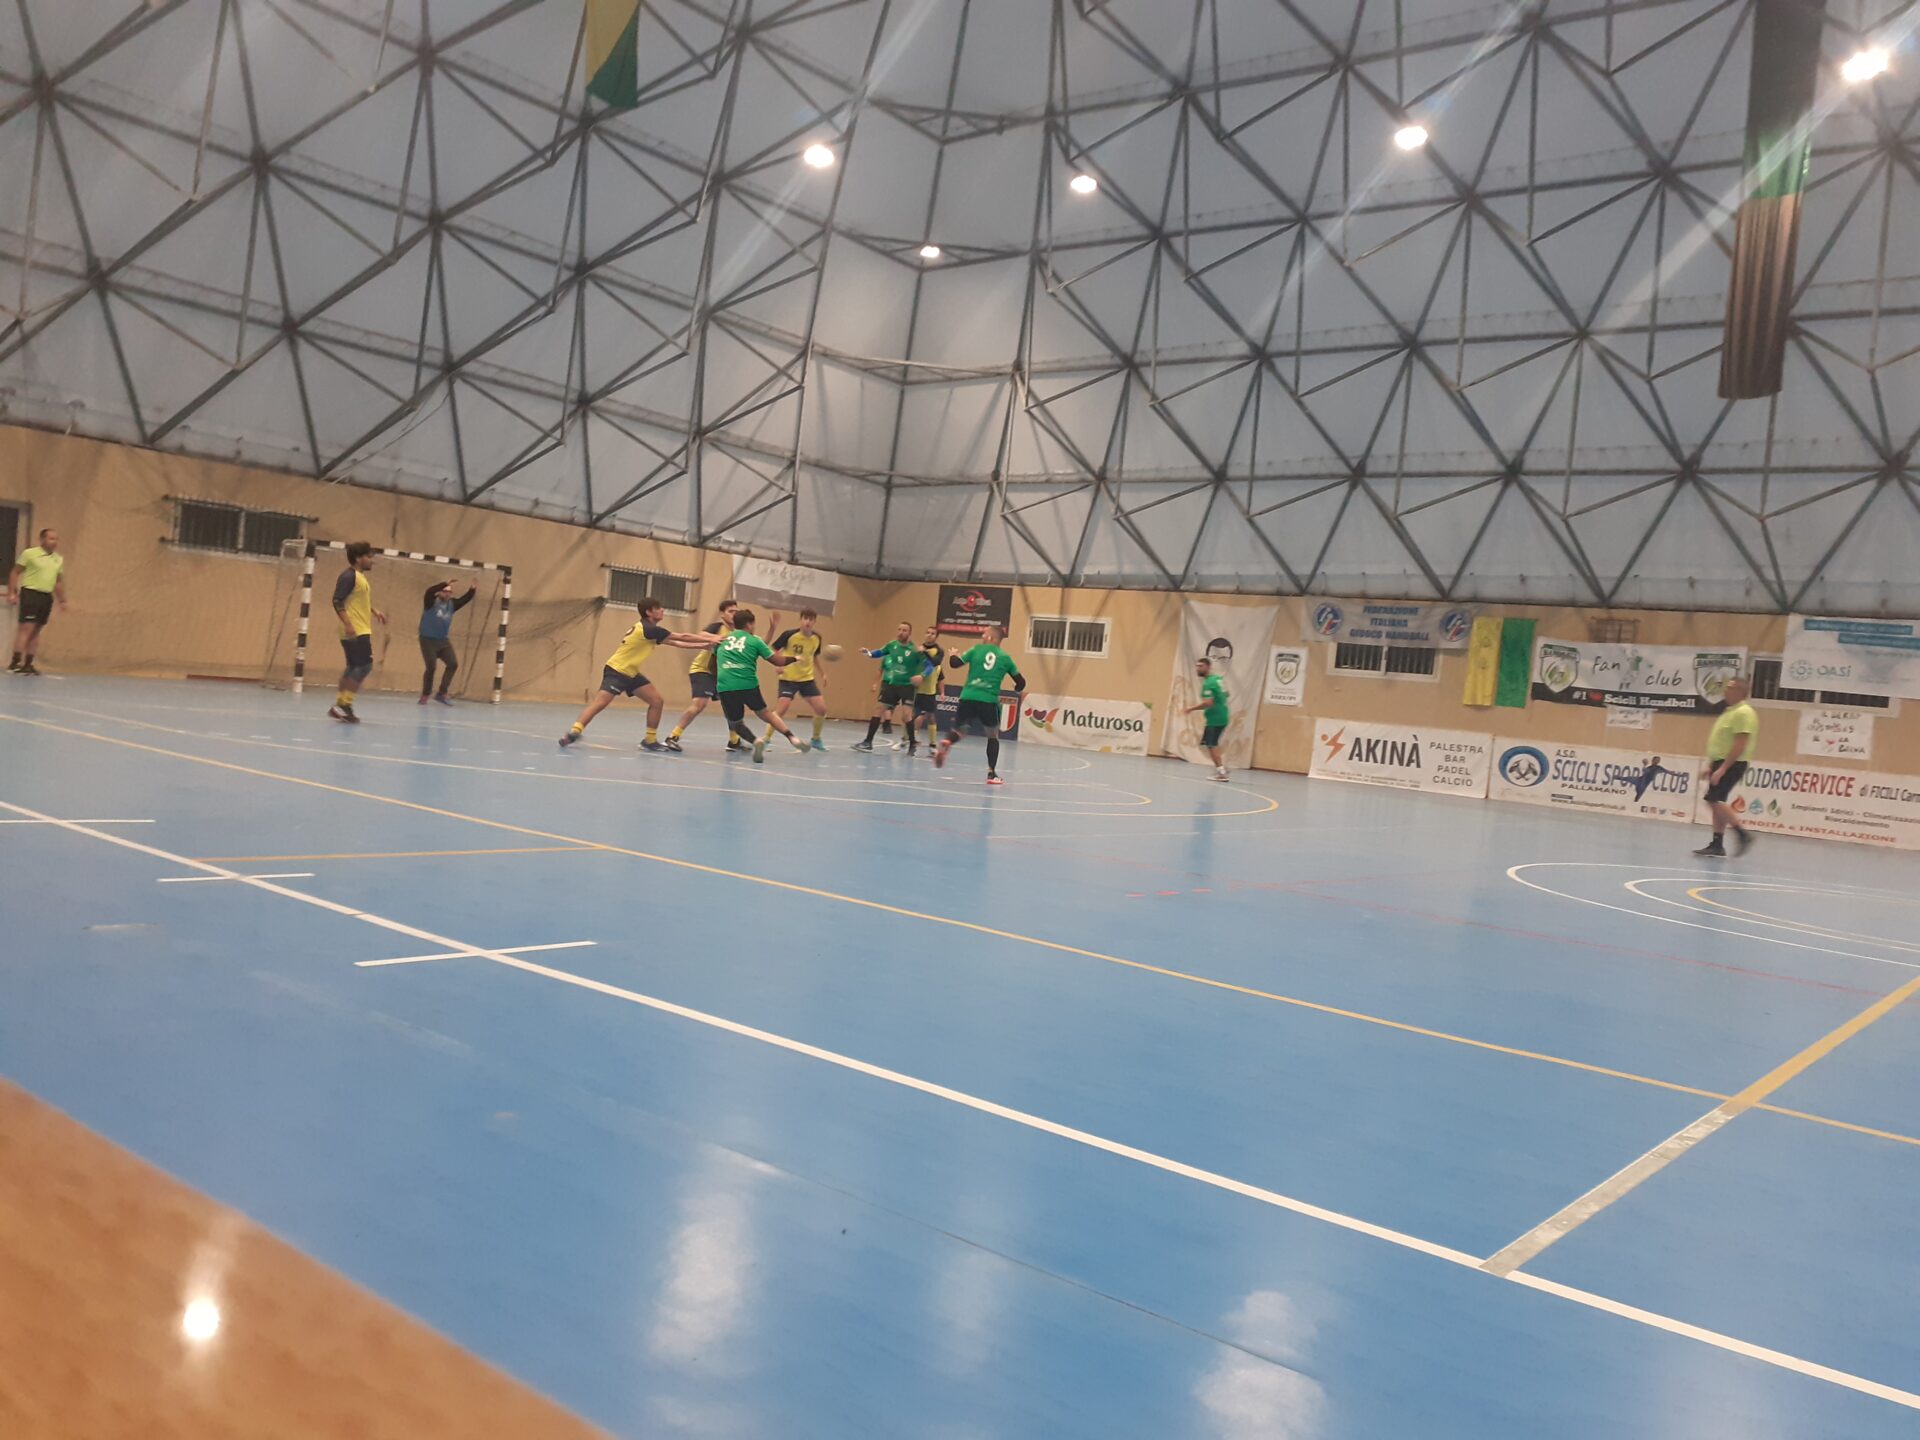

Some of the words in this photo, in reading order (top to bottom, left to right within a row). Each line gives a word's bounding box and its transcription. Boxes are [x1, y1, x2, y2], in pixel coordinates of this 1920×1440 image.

[724, 635, 747, 652] 34
[983, 651, 997, 671] 9
[1645, 669, 1683, 687] club
[1572, 690, 1587, 700] #1
[1604, 693, 1637, 705] Scicli
[1639, 696, 1696, 708] Handball
[1062, 709, 1144, 733] Naturosa
[1348, 734, 1422, 769] AKINÀ
[1429, 741, 1484, 754] PALESTRA
[1444, 754, 1467, 764] BAR
[1437, 764, 1471, 776] PADEL
[1552, 758, 1600, 784] SCICLI
[1602, 763, 1646, 789] SPOR
[1652, 768, 1691, 794] CLUB
[1432, 775, 1474, 787] CALCIO
[1560, 782, 1628, 796] PALLAMANO
[1742, 766, 1857, 798] OIDROSERVICE
[1799, 825, 1897, 843] INSTALLAZIONE
